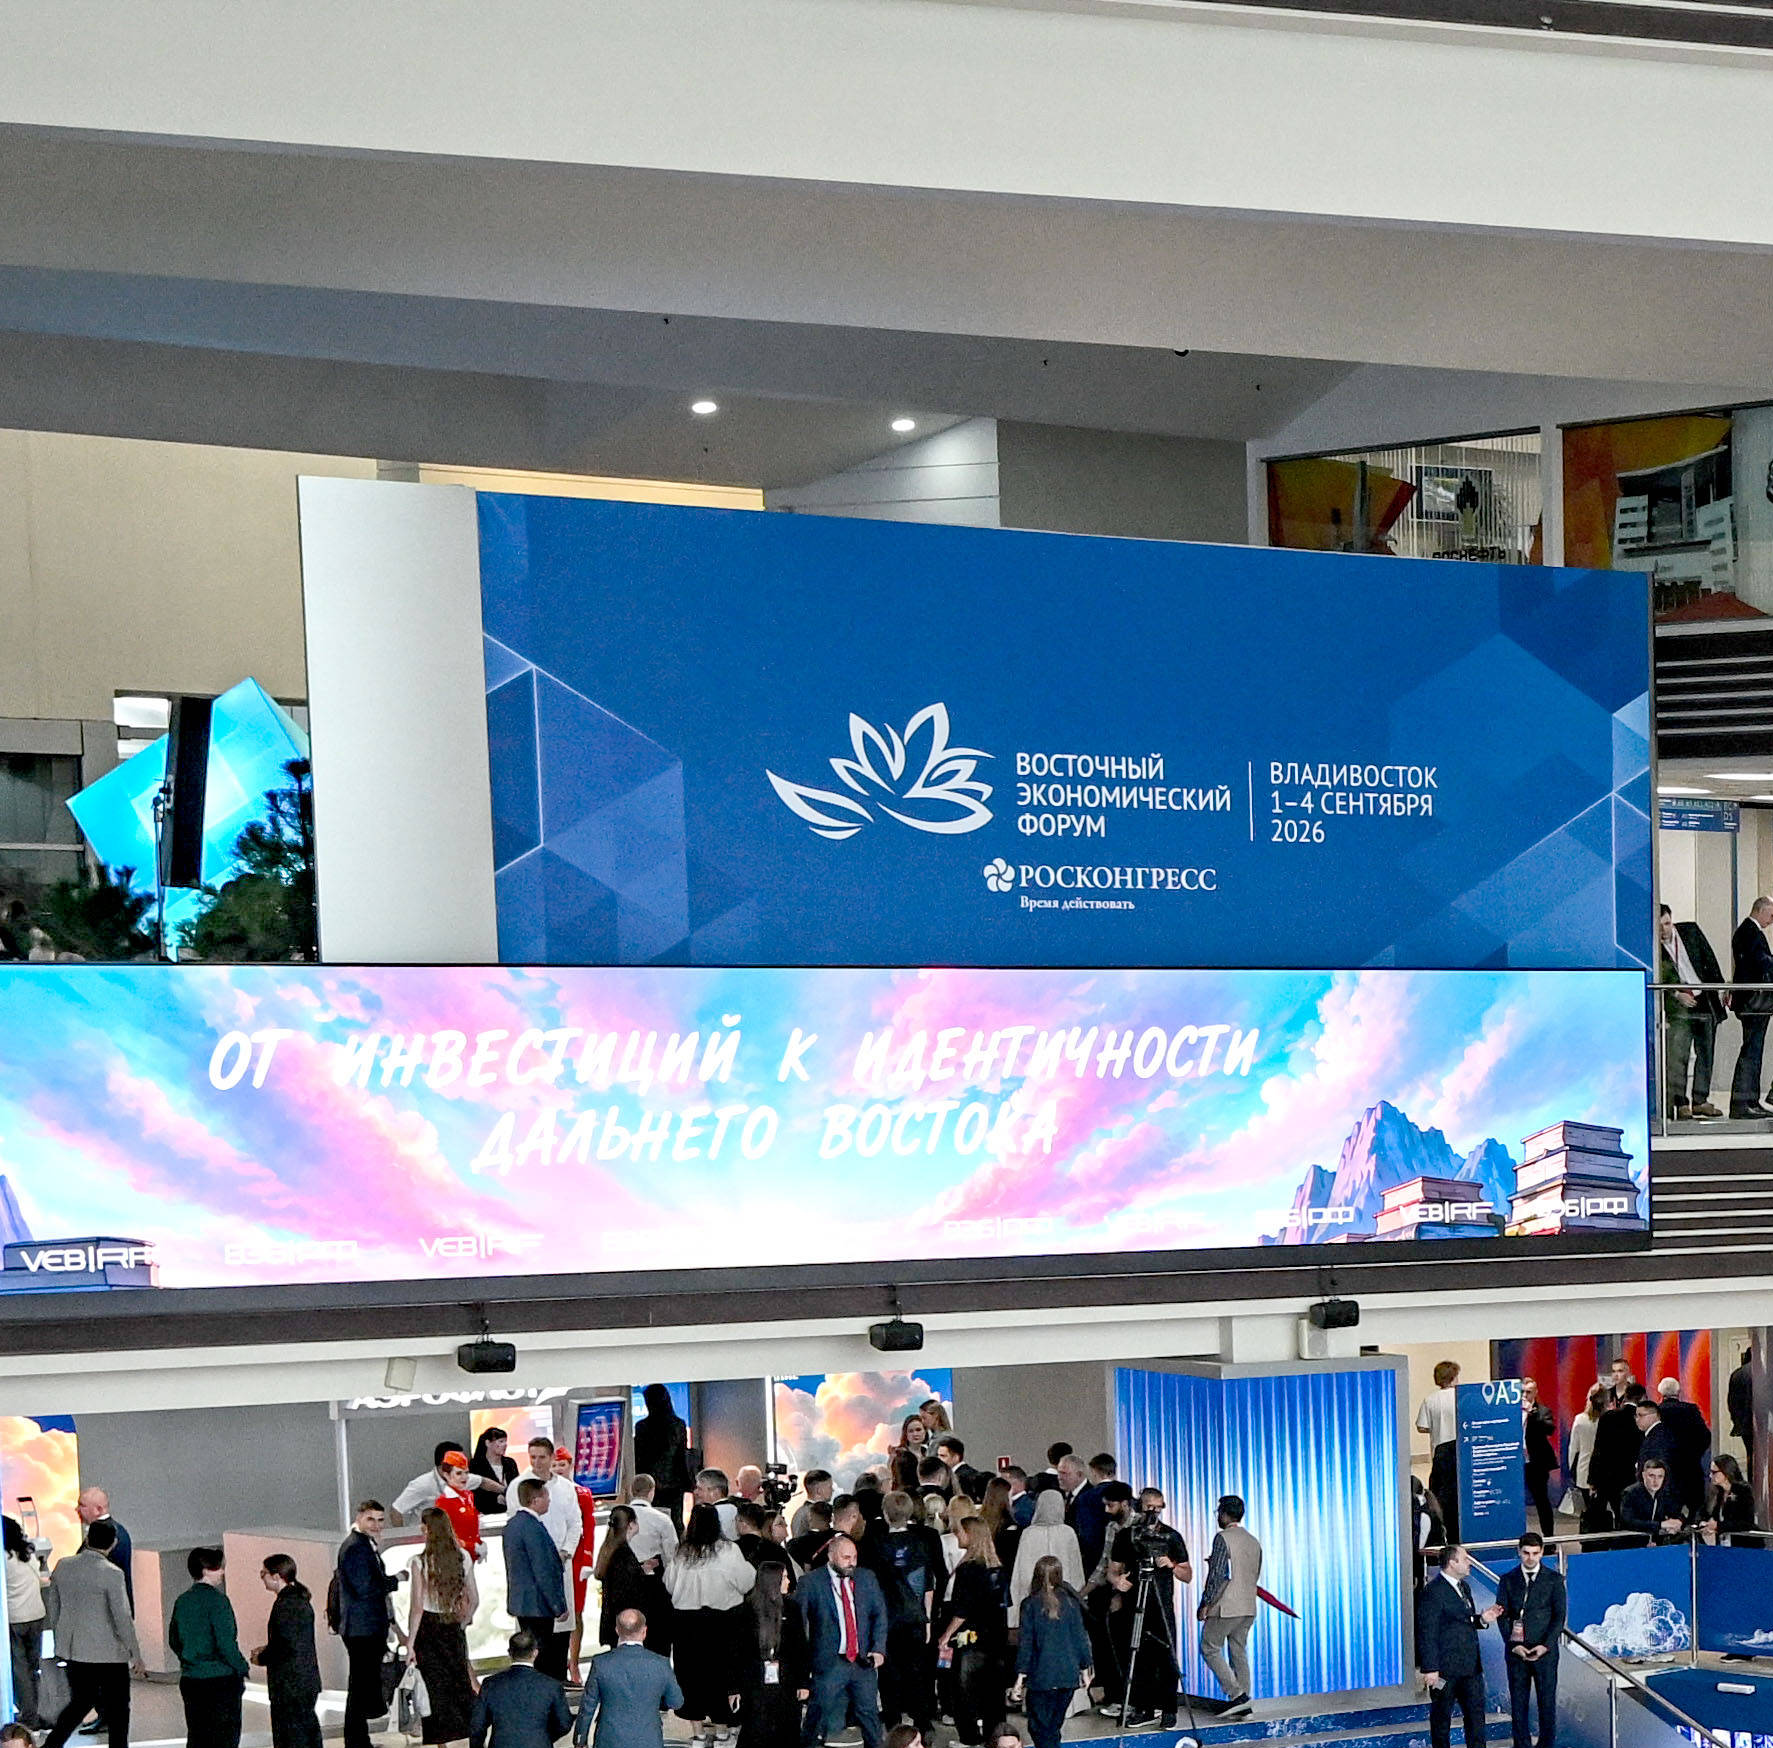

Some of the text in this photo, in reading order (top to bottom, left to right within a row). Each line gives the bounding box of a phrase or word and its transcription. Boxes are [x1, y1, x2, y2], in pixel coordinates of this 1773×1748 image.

[1017, 752, 1165, 780] ВОСТОЧНЫЙ
[1270, 761, 1439, 789] ВЛАДИВОСТОК
[1017, 782, 1232, 812] ЭКОНОМИЧЕСКИЙ
[1320, 793, 1434, 817] СЕНТЯБРЯ
[1017, 815, 1106, 838] ФОРУМ
[1271, 819, 1326, 843] 2026
[1018, 864, 1218, 891] РОСКОНГРЕСС
[1020, 895, 1135, 911] Время действовать
[208, 1012, 1261, 1096] ОТ ИНВЕСТИЦИЙ К ИДЕНТИЧНОСТИ
[472, 1099, 1059, 1176] ДАЛЬНЕГО ВОСТОКА
